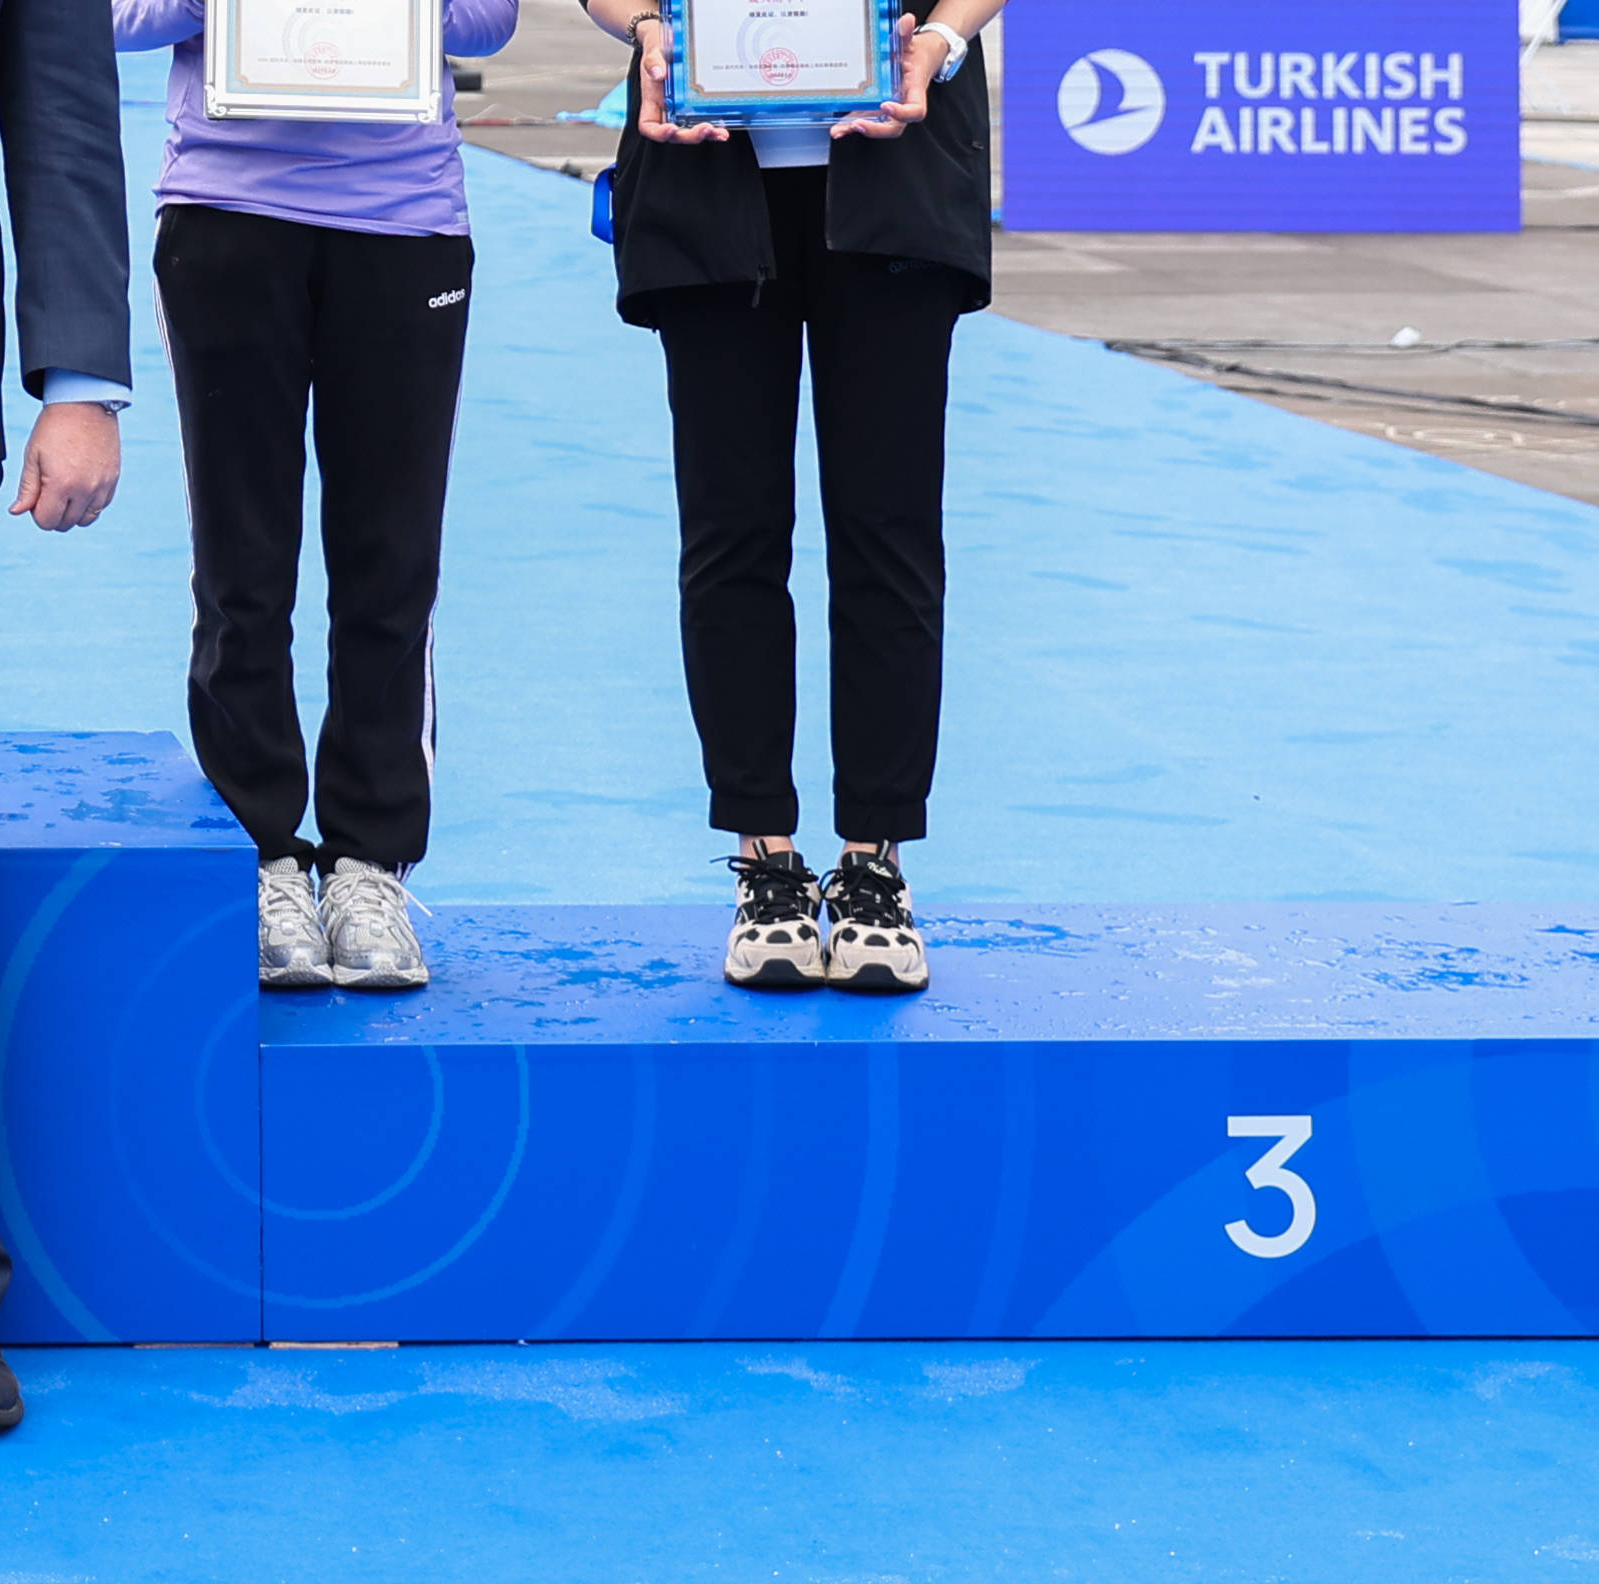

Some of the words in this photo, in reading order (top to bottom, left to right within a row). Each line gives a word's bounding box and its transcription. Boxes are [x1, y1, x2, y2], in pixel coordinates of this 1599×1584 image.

[1193, 52, 1464, 100] TURKISH
[1190, 106, 1468, 154] AIRLINES
[428, 289, 466, 308] adidas
[1224, 1115, 1317, 1258] 3
